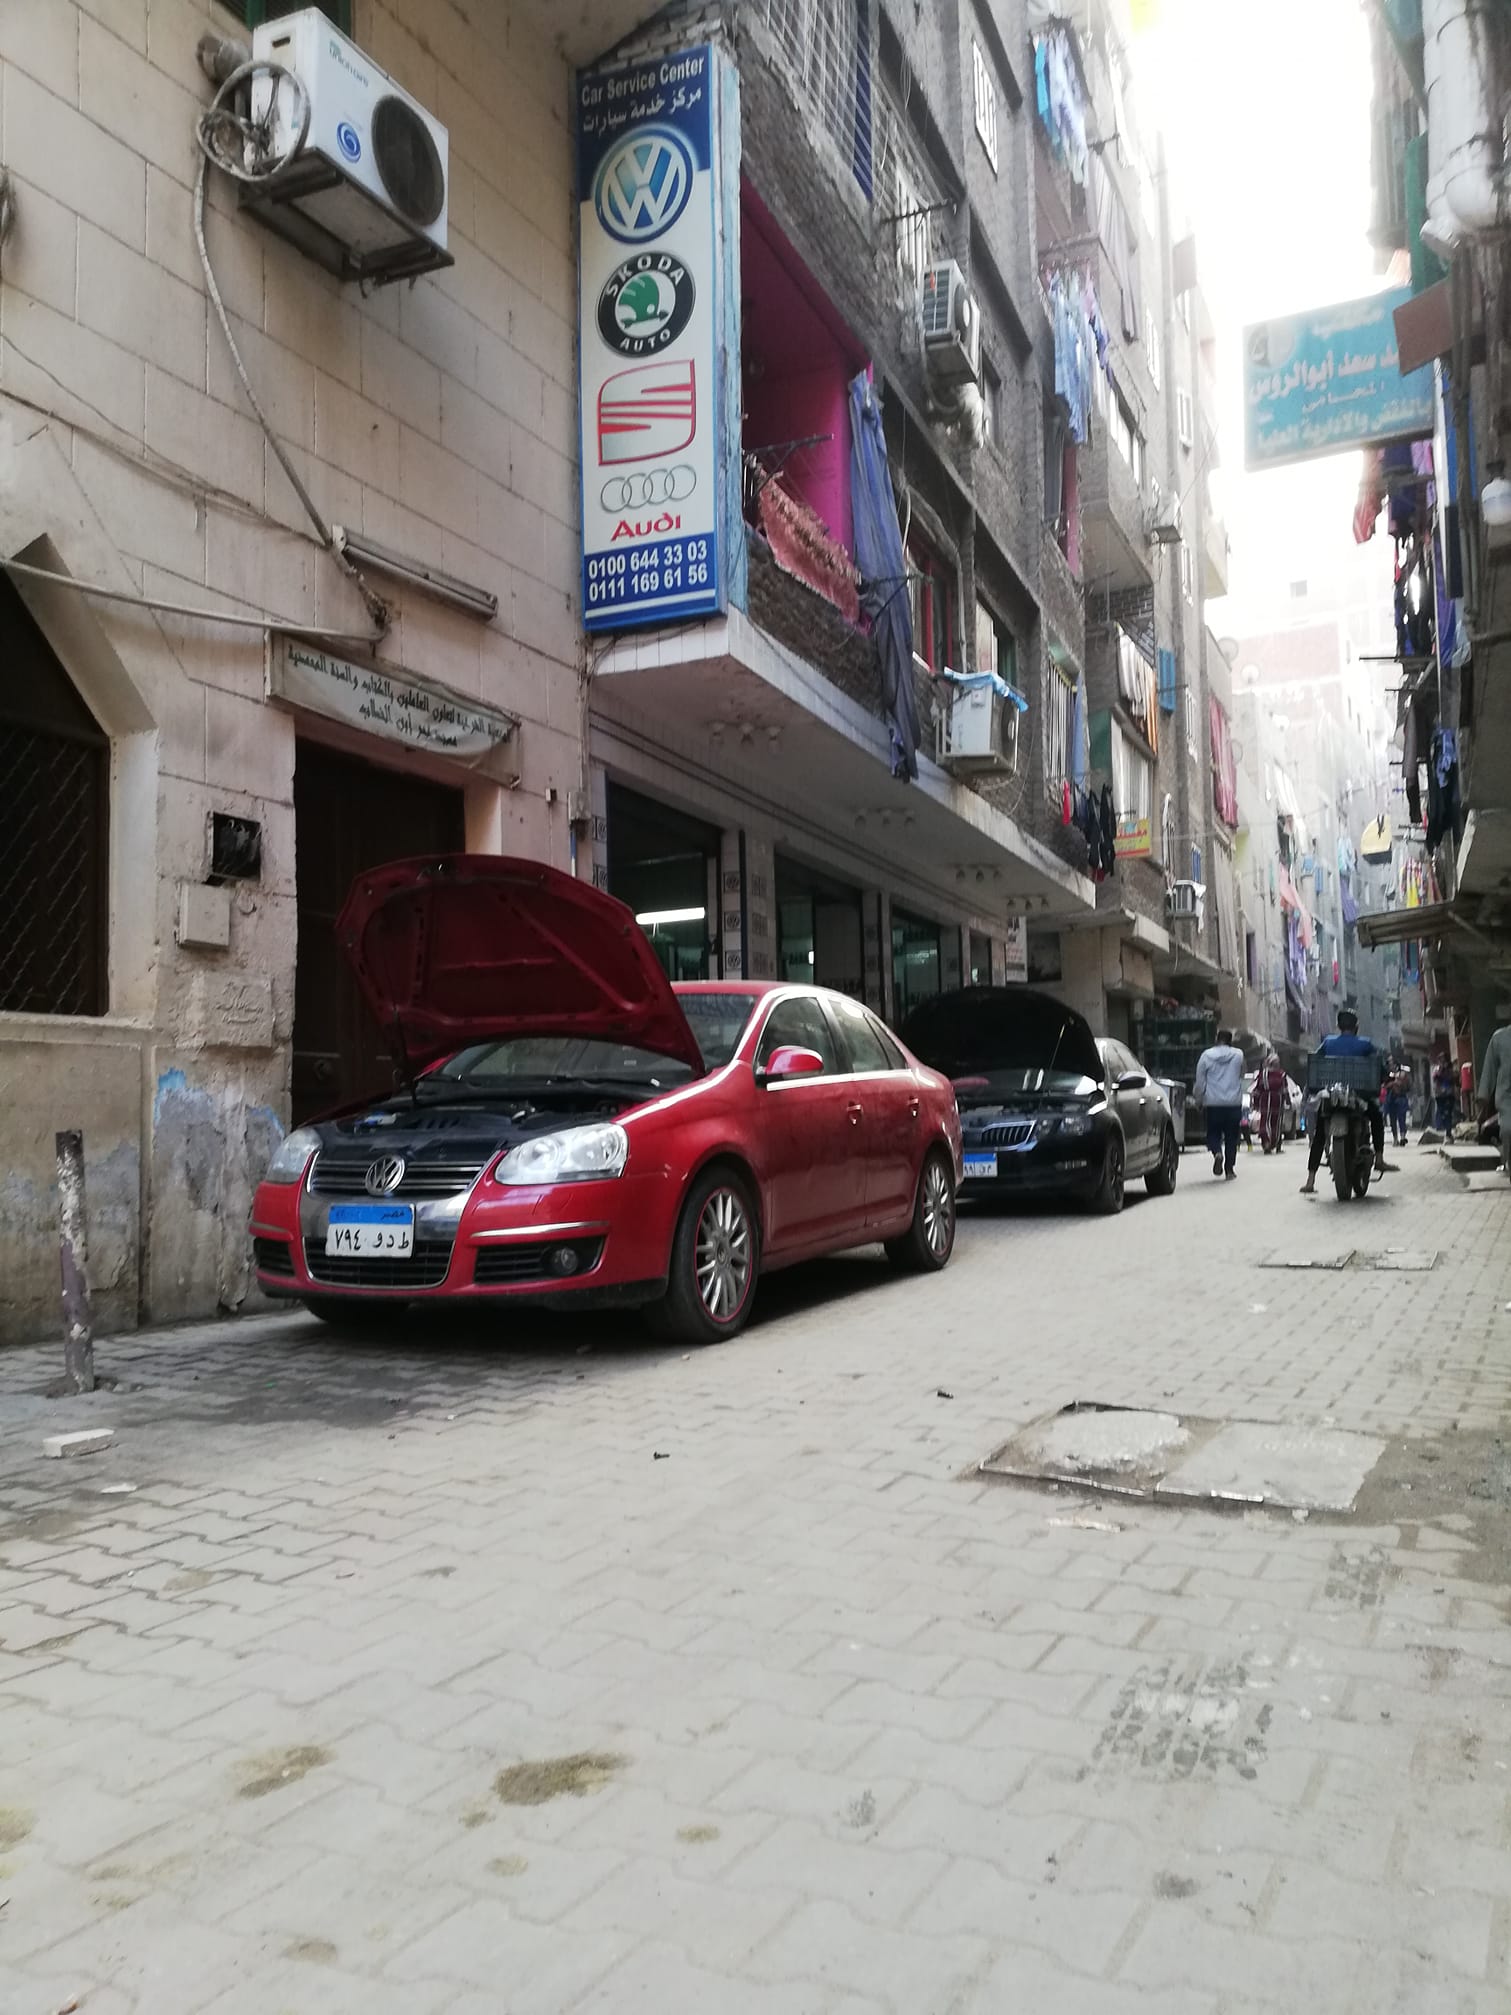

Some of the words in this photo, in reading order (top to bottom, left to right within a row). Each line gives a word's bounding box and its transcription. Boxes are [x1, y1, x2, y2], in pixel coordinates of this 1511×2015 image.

[581, 83, 603, 106] Car
[607, 71, 656, 100] Service
[659, 55, 706, 85] Center
[630, 96, 666, 119] خدمة
[668, 86, 703, 115] مركز
[583, 111, 628, 138] سيارات
[605, 254, 686, 298] SKODA
[619, 328, 672, 352] AUTO
[611, 512, 681, 542] Audi
[588, 554, 626, 579] 0100
[630, 548, 659, 571] 644
[664, 544, 682, 566] 33
[687, 540, 707, 561] 03
[589, 577, 625, 602] 0111
[631, 571, 659, 594] 169
[664, 567, 681, 589] 61
[688, 562, 707, 585] 56
